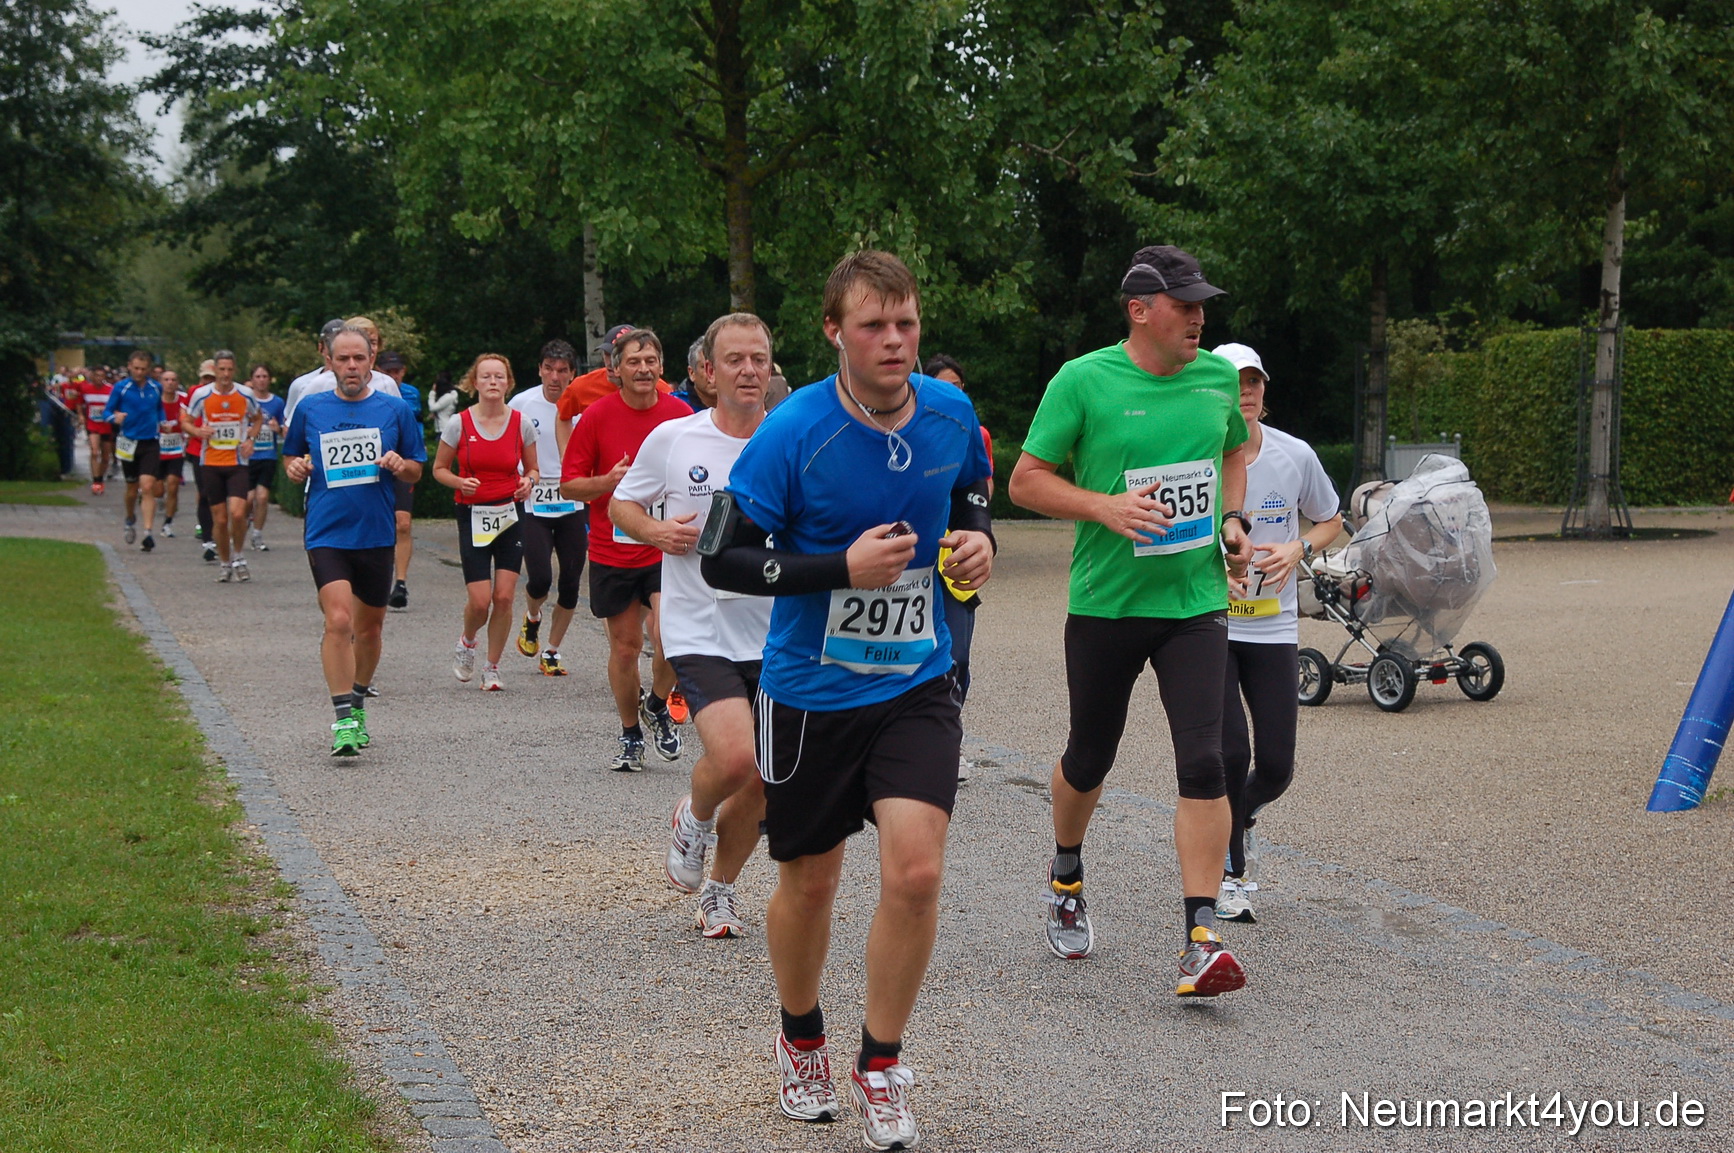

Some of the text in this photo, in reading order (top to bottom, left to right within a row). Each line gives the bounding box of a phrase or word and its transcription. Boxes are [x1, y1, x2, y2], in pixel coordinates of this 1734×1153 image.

[217, 428, 235, 439] 149
[328, 441, 377, 466] 2233
[341, 468, 367, 478] Stefan
[1162, 470, 1202, 483] Neumarkt
[1143, 481, 1210, 519] 655
[482, 514, 508, 532] 54
[839, 594, 926, 636] 2973
[1228, 603, 1255, 615] Anika
[864, 645, 901, 661] Felix
